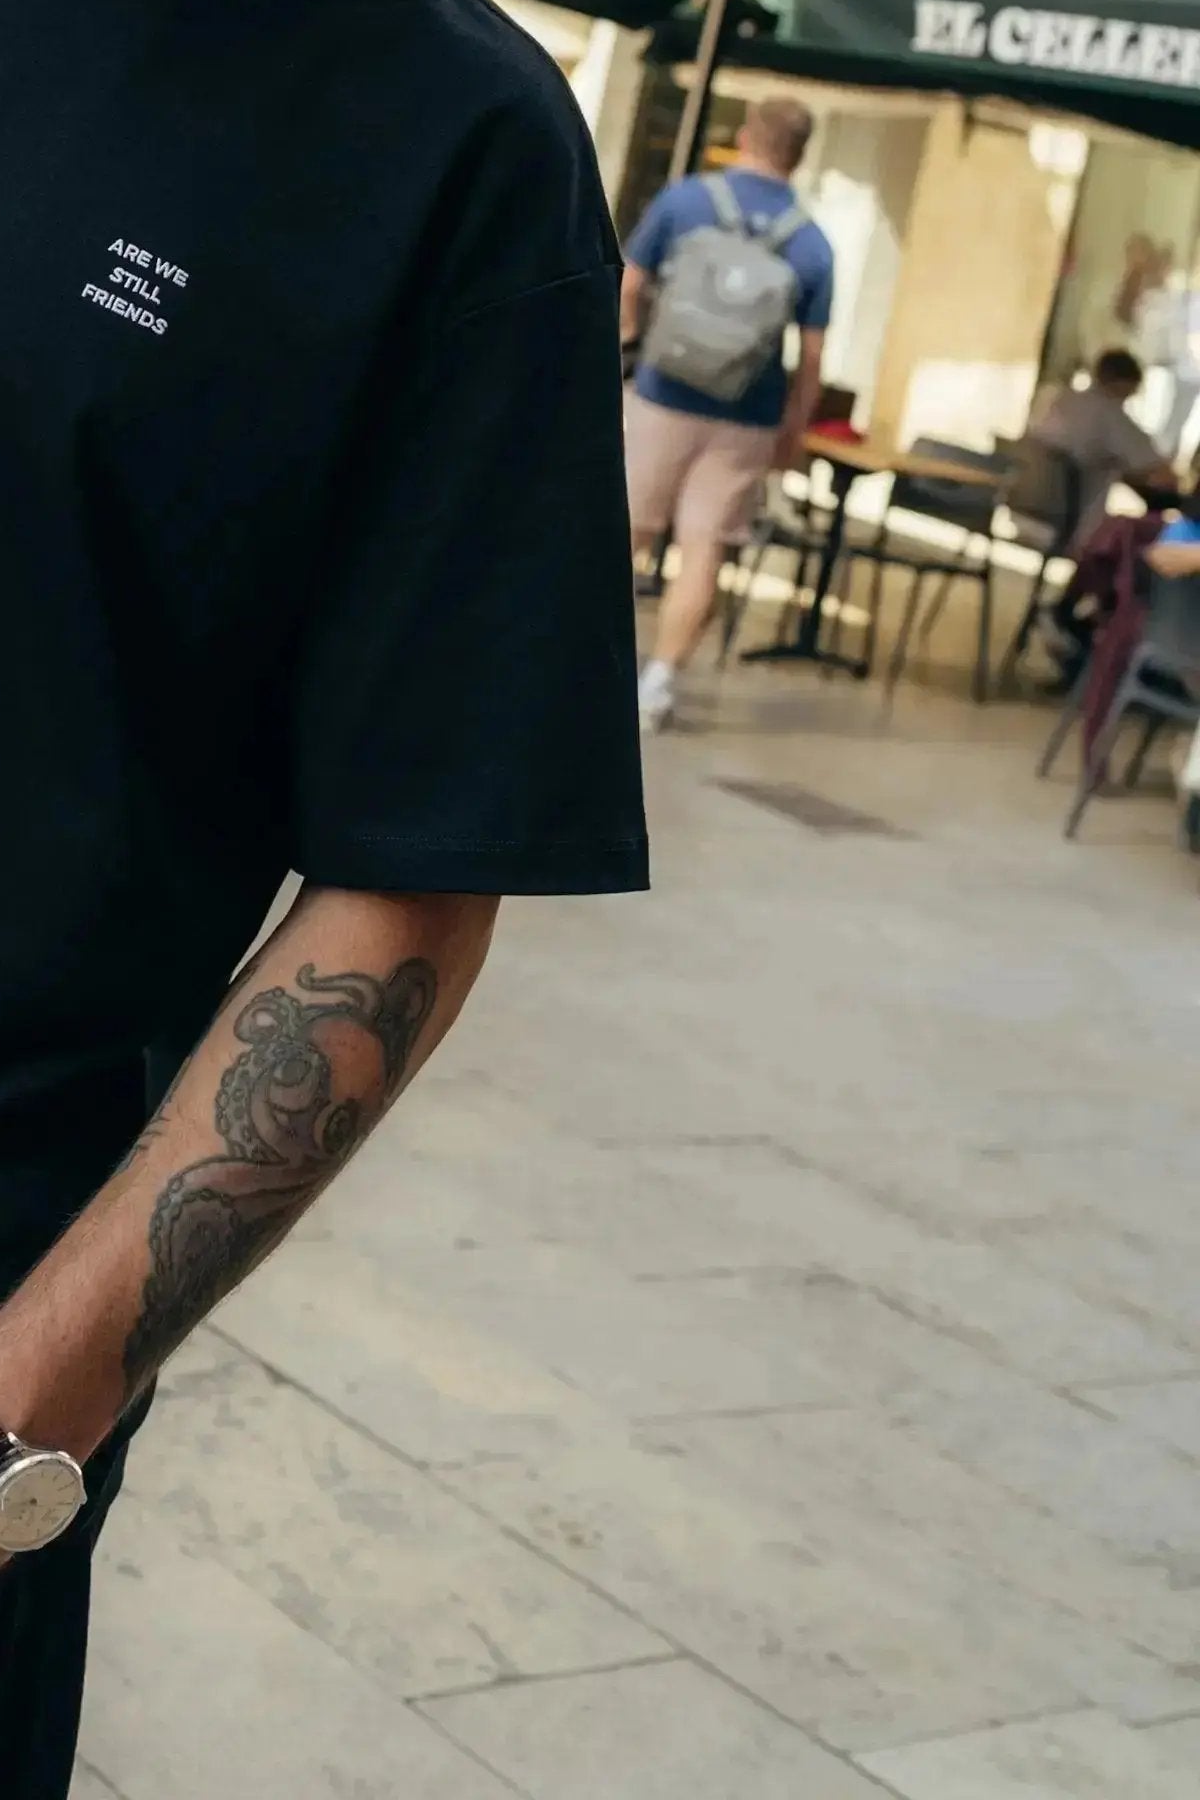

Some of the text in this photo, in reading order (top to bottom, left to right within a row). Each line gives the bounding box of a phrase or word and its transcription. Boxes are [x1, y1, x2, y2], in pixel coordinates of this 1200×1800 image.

[107, 238, 189, 288] ARE WE
[108, 267, 161, 305] STILL
[81, 283, 168, 335] FRIENDS
